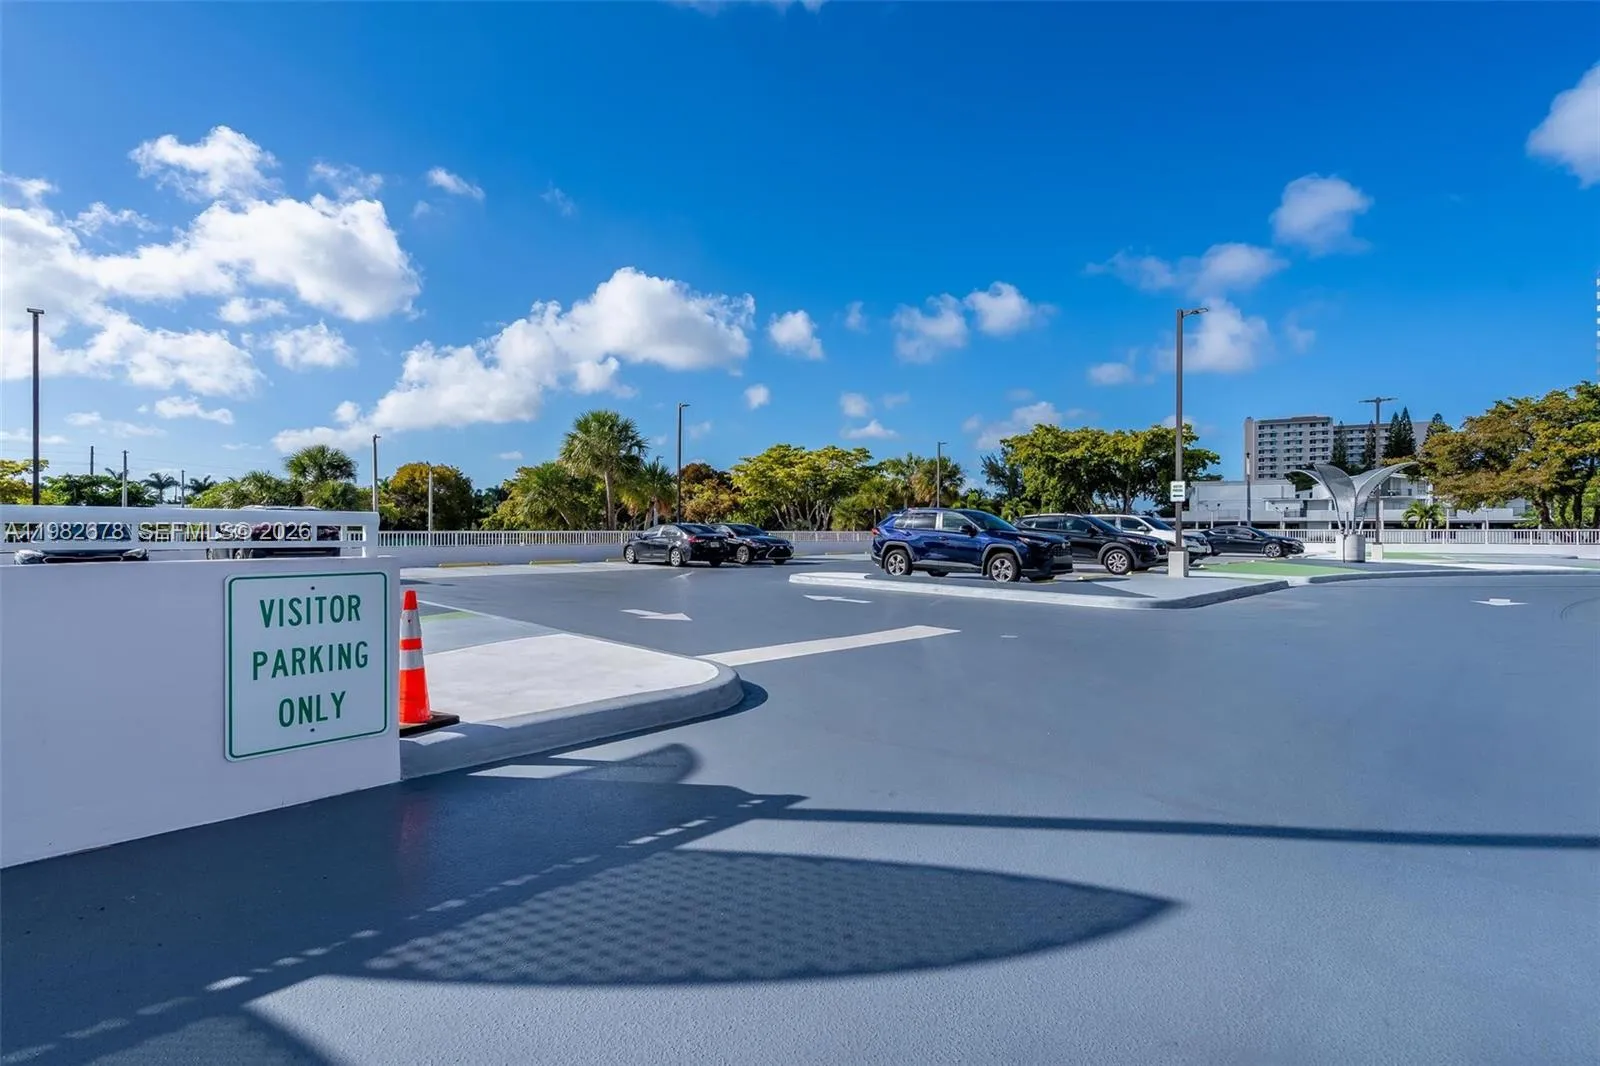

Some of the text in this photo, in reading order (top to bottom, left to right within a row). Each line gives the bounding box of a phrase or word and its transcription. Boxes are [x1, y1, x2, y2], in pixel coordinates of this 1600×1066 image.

[260, 594, 361, 628] VISITOR
[252, 641, 369, 681] PARKING
[278, 691, 346, 728] ONLY
